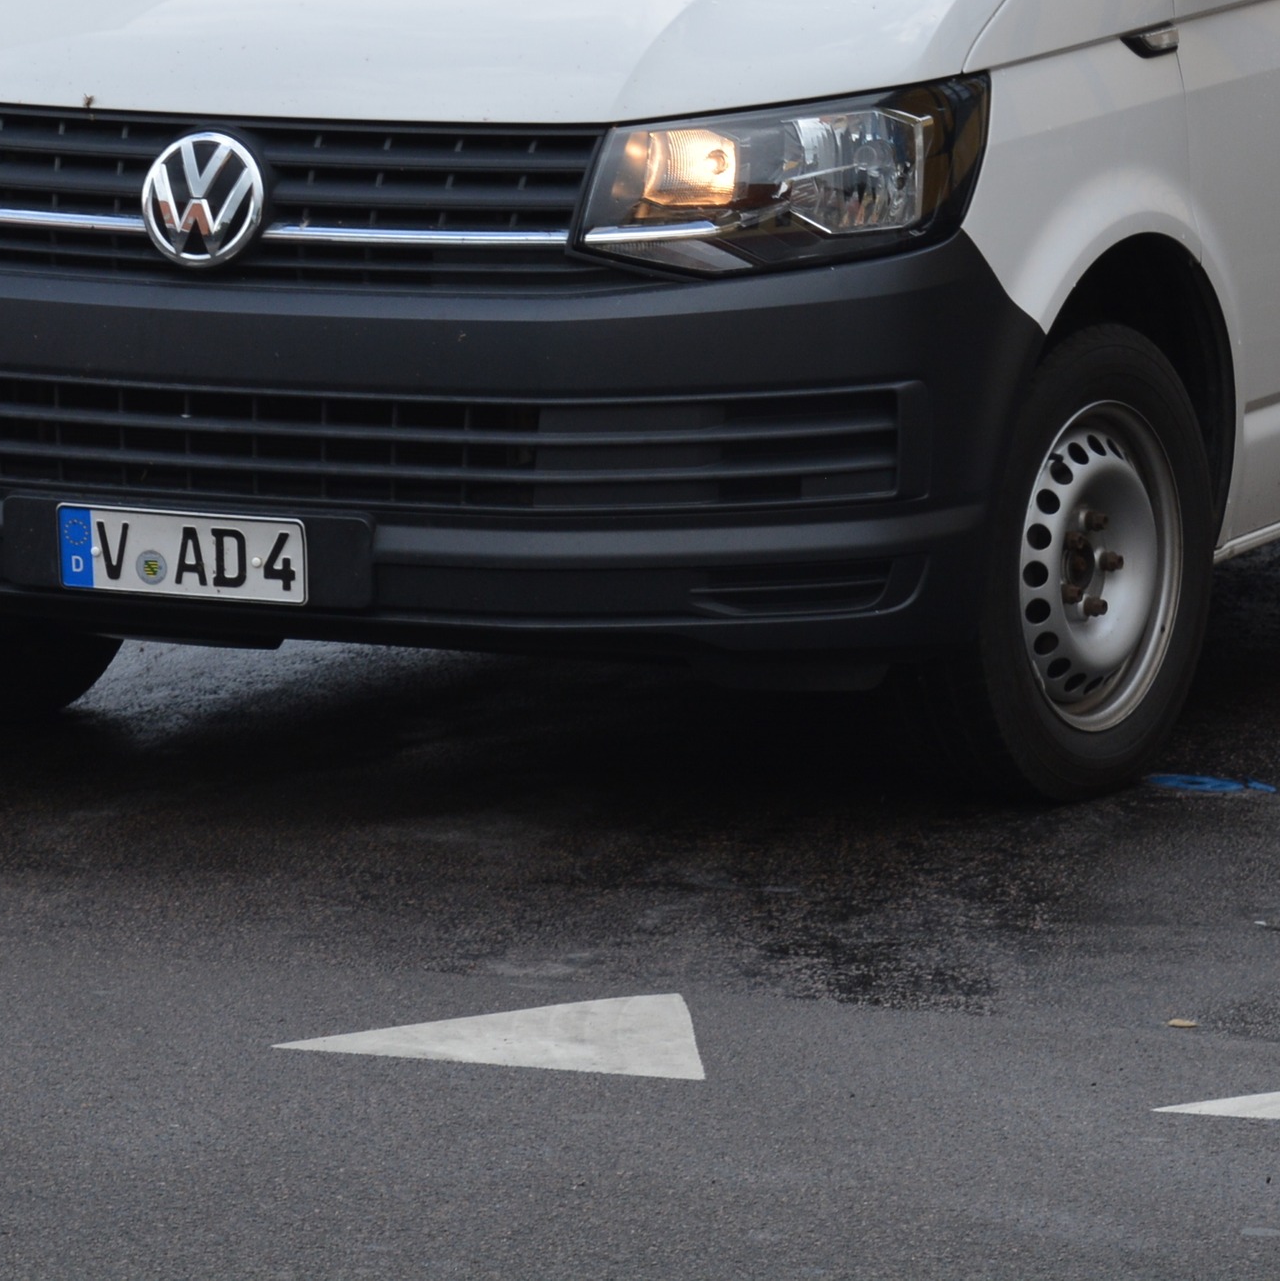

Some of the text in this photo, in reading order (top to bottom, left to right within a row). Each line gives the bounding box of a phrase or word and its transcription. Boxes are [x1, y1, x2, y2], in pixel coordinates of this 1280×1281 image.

[141, 131, 264, 268] VW
[71, 555, 84, 573] D
[96, 520, 130, 581] V
